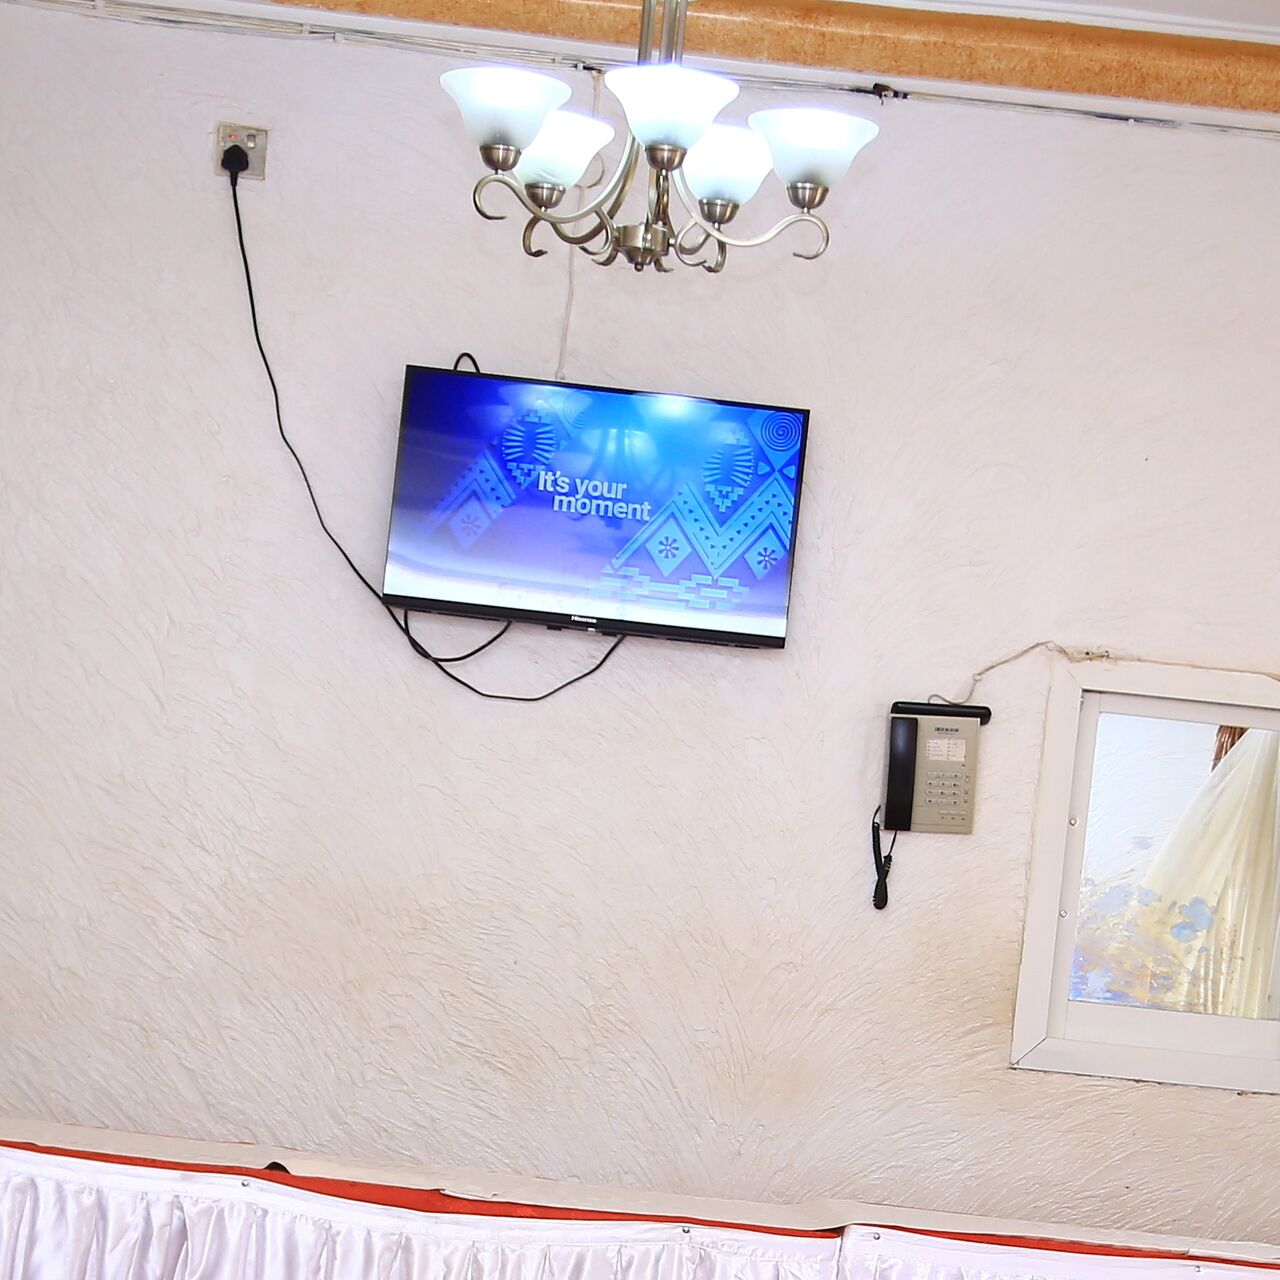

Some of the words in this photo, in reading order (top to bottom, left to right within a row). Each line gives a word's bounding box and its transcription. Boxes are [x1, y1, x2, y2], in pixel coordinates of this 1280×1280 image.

[538, 470, 570, 493] It's
[575, 478, 627, 499] your
[553, 494, 651, 520] moment
